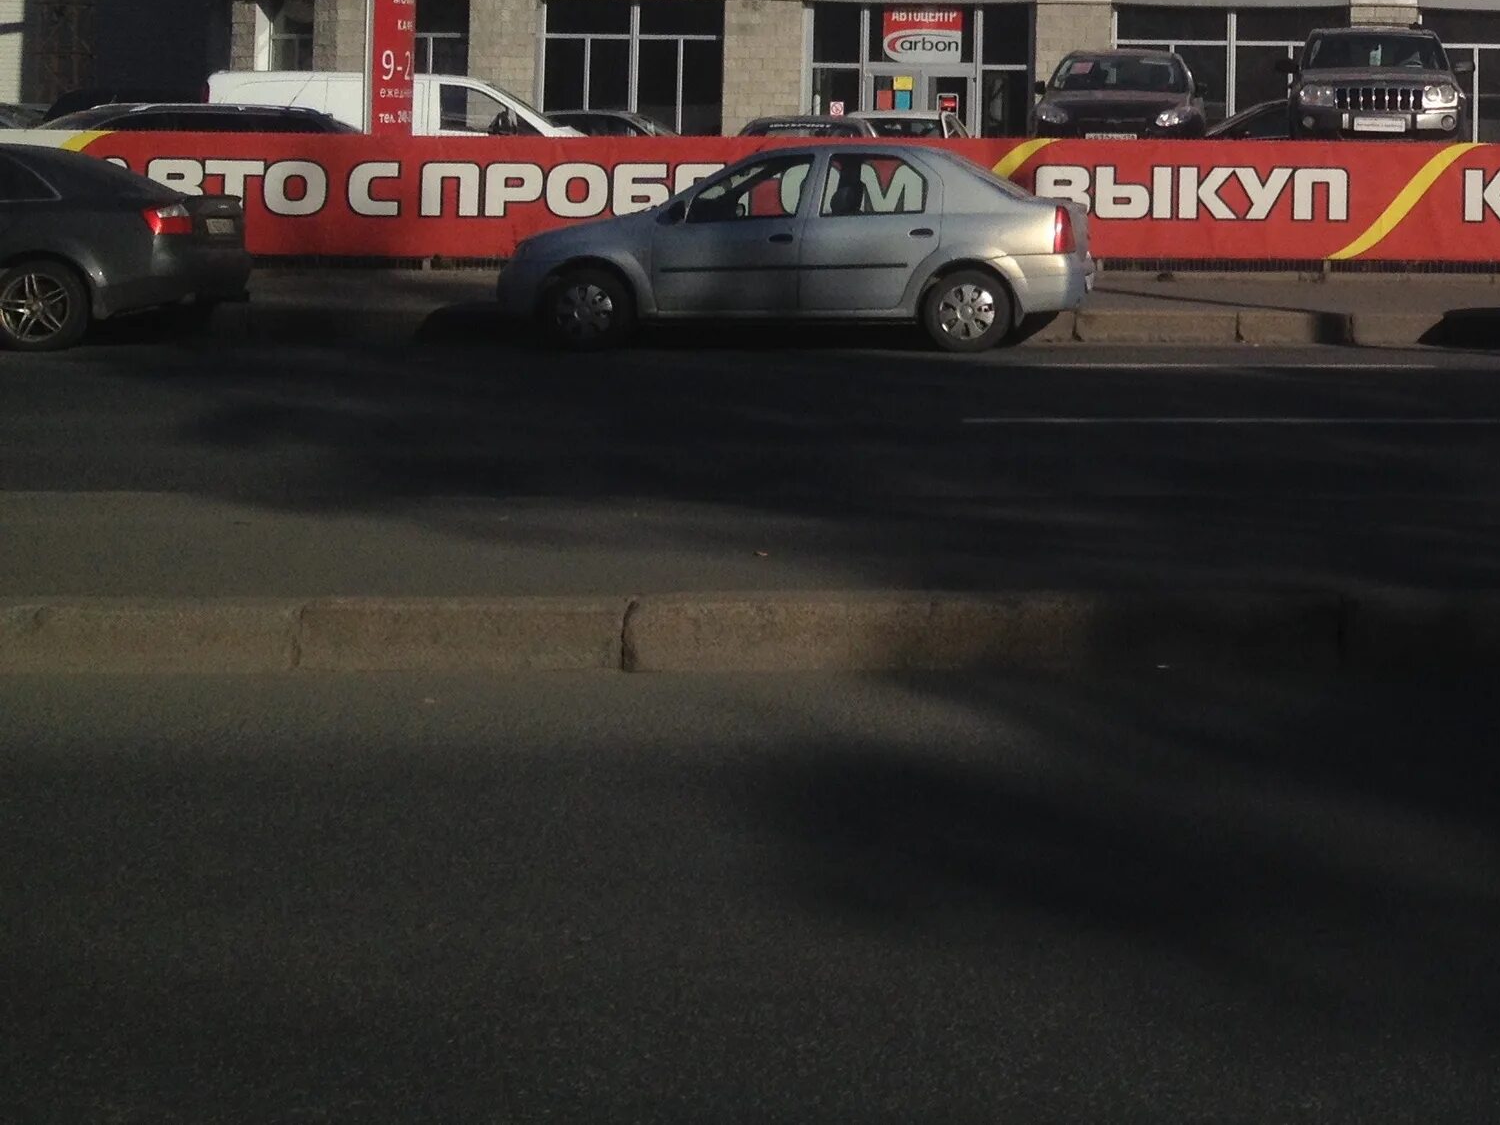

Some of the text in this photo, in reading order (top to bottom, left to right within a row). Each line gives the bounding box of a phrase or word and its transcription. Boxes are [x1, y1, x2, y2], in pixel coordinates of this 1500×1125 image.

[105, 157, 328, 216] ВТО
[347, 159, 400, 217] С
[1035, 164, 1348, 221] ВЫКУП
